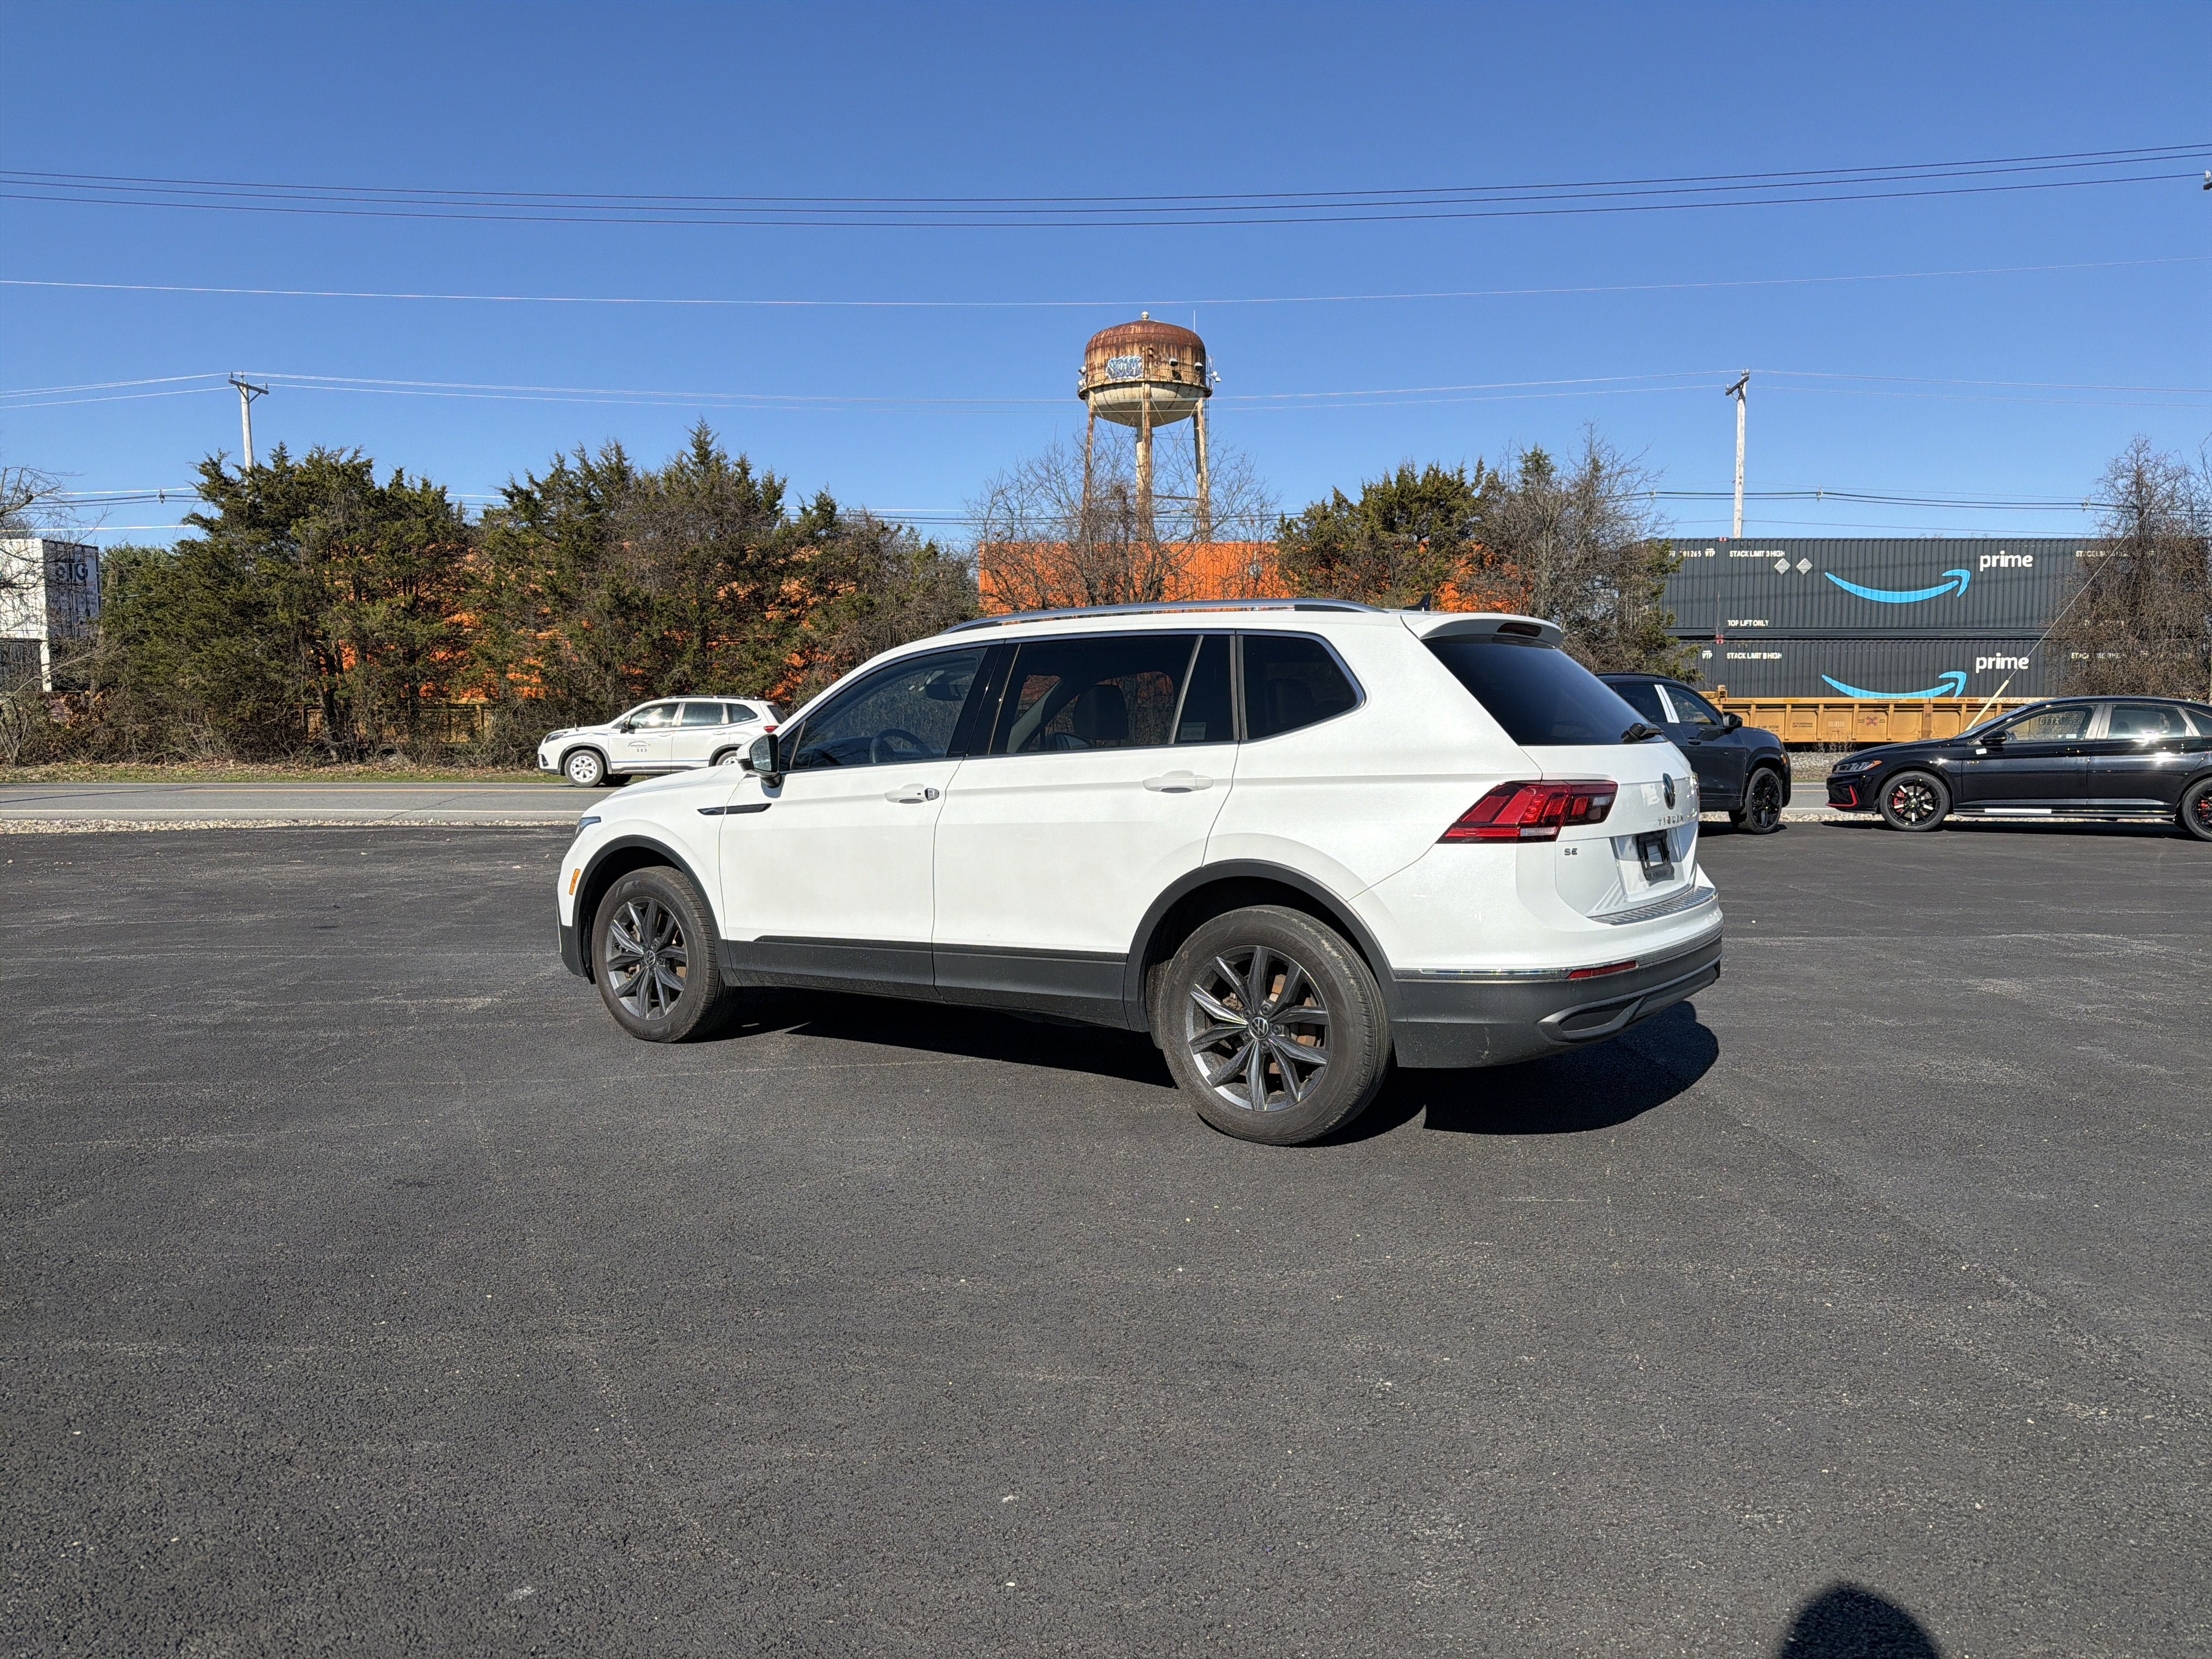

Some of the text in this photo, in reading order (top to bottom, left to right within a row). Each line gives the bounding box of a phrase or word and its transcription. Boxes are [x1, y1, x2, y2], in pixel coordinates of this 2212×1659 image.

[1979, 550, 2033, 572] prime
[1976, 652, 2029, 674] prime
[1657, 812, 1684, 826] TIGUAN
[1564, 848, 1578, 856] SE
